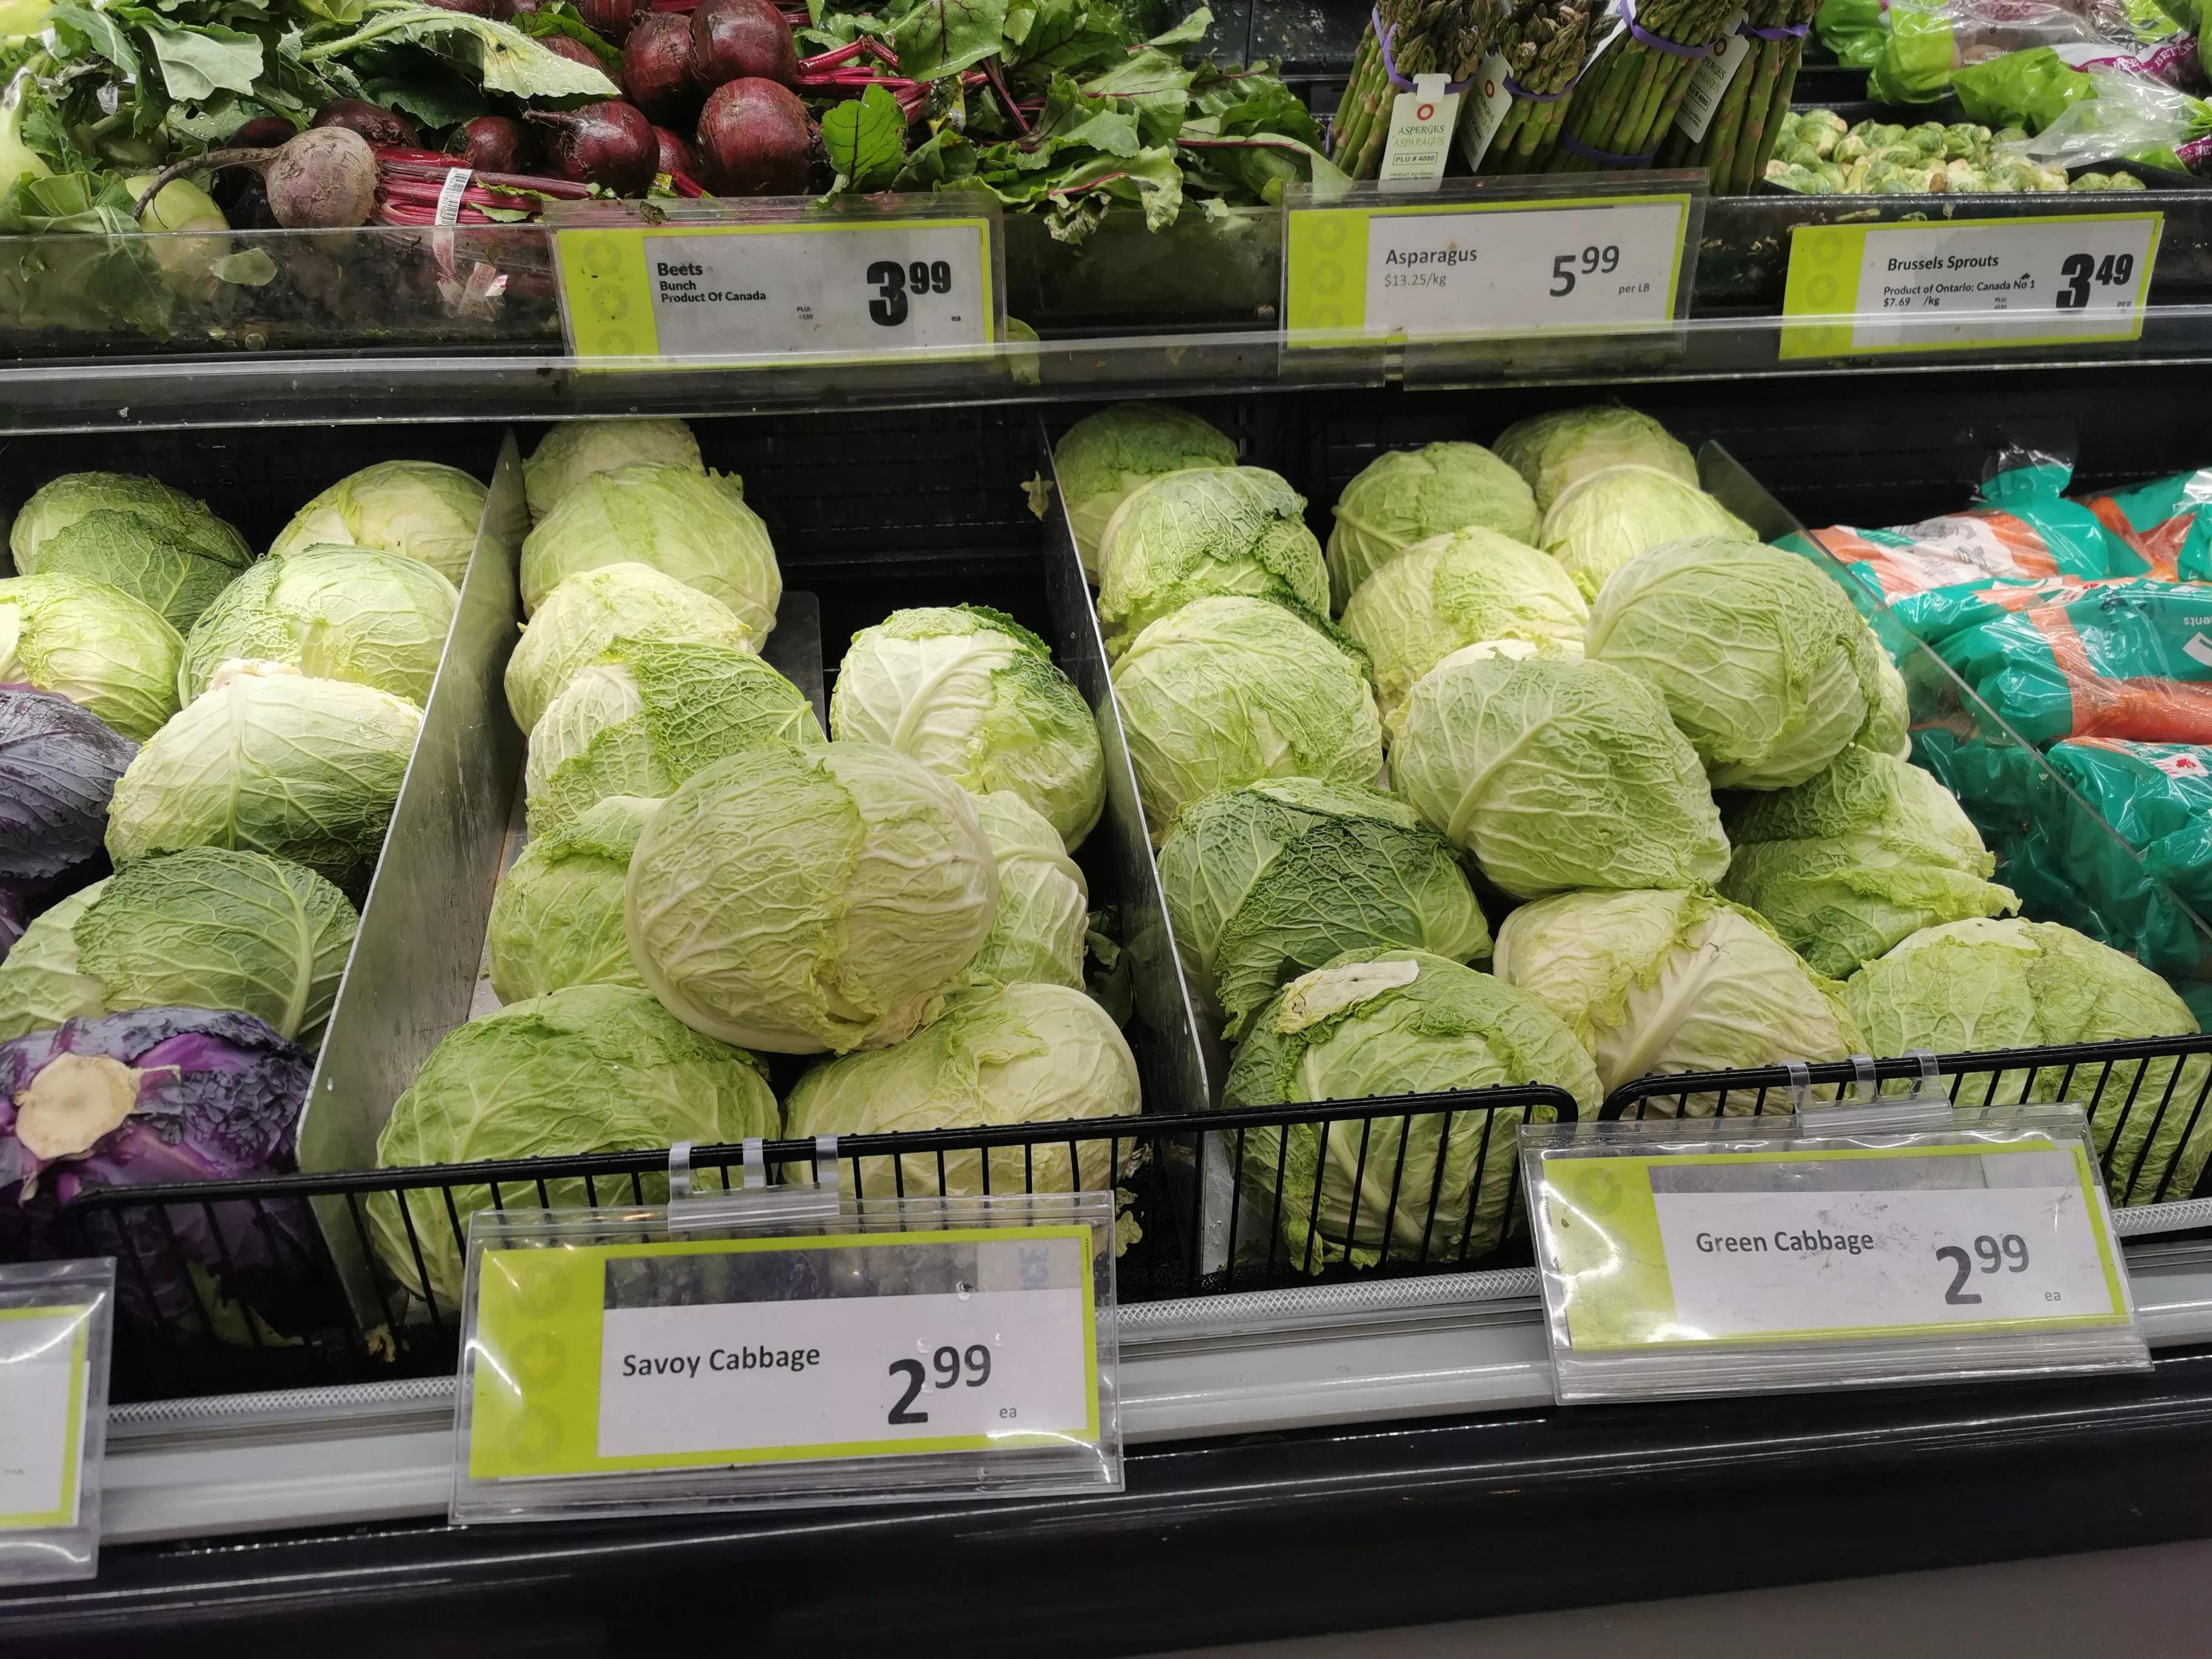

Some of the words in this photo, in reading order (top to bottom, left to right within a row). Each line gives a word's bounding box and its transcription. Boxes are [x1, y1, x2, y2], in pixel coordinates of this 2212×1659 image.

[1398, 124, 1445, 135] ASPERGES
[1394, 136, 1445, 147] ASPARAGUS
[1386, 249, 1478, 268] Asparagus
[1888, 256, 1943, 271] Brussels
[1946, 254, 1999, 270] Sprouts
[657, 263, 703, 276] Beets
[660, 280, 697, 291] Bunch
[1384, 272, 1447, 288] $13.25/kg
[1618, 285, 1635, 295] per
[1638, 283, 1650, 292] LB
[1884, 285, 1921, 295] Product
[1923, 284, 1934, 293] of
[1977, 280, 2011, 291] Canada
[2013, 280, 2027, 290] No
[2030, 280, 2035, 289] 1
[661, 293, 706, 303] Product
[708, 292, 723, 301] Of
[725, 291, 766, 301] Canada
[1883, 297, 1911, 307] $7.69
[1923, 295, 1940, 307] /kg
[1696, 1232, 1768, 1253] Green
[1774, 1230, 1874, 1255] Cabbage
[2045, 1291, 2061, 1301] ea
[623, 1354, 701, 1378] Savoy
[709, 1346, 820, 1372] Cabbage
[999, 1407, 1017, 1418] ea
